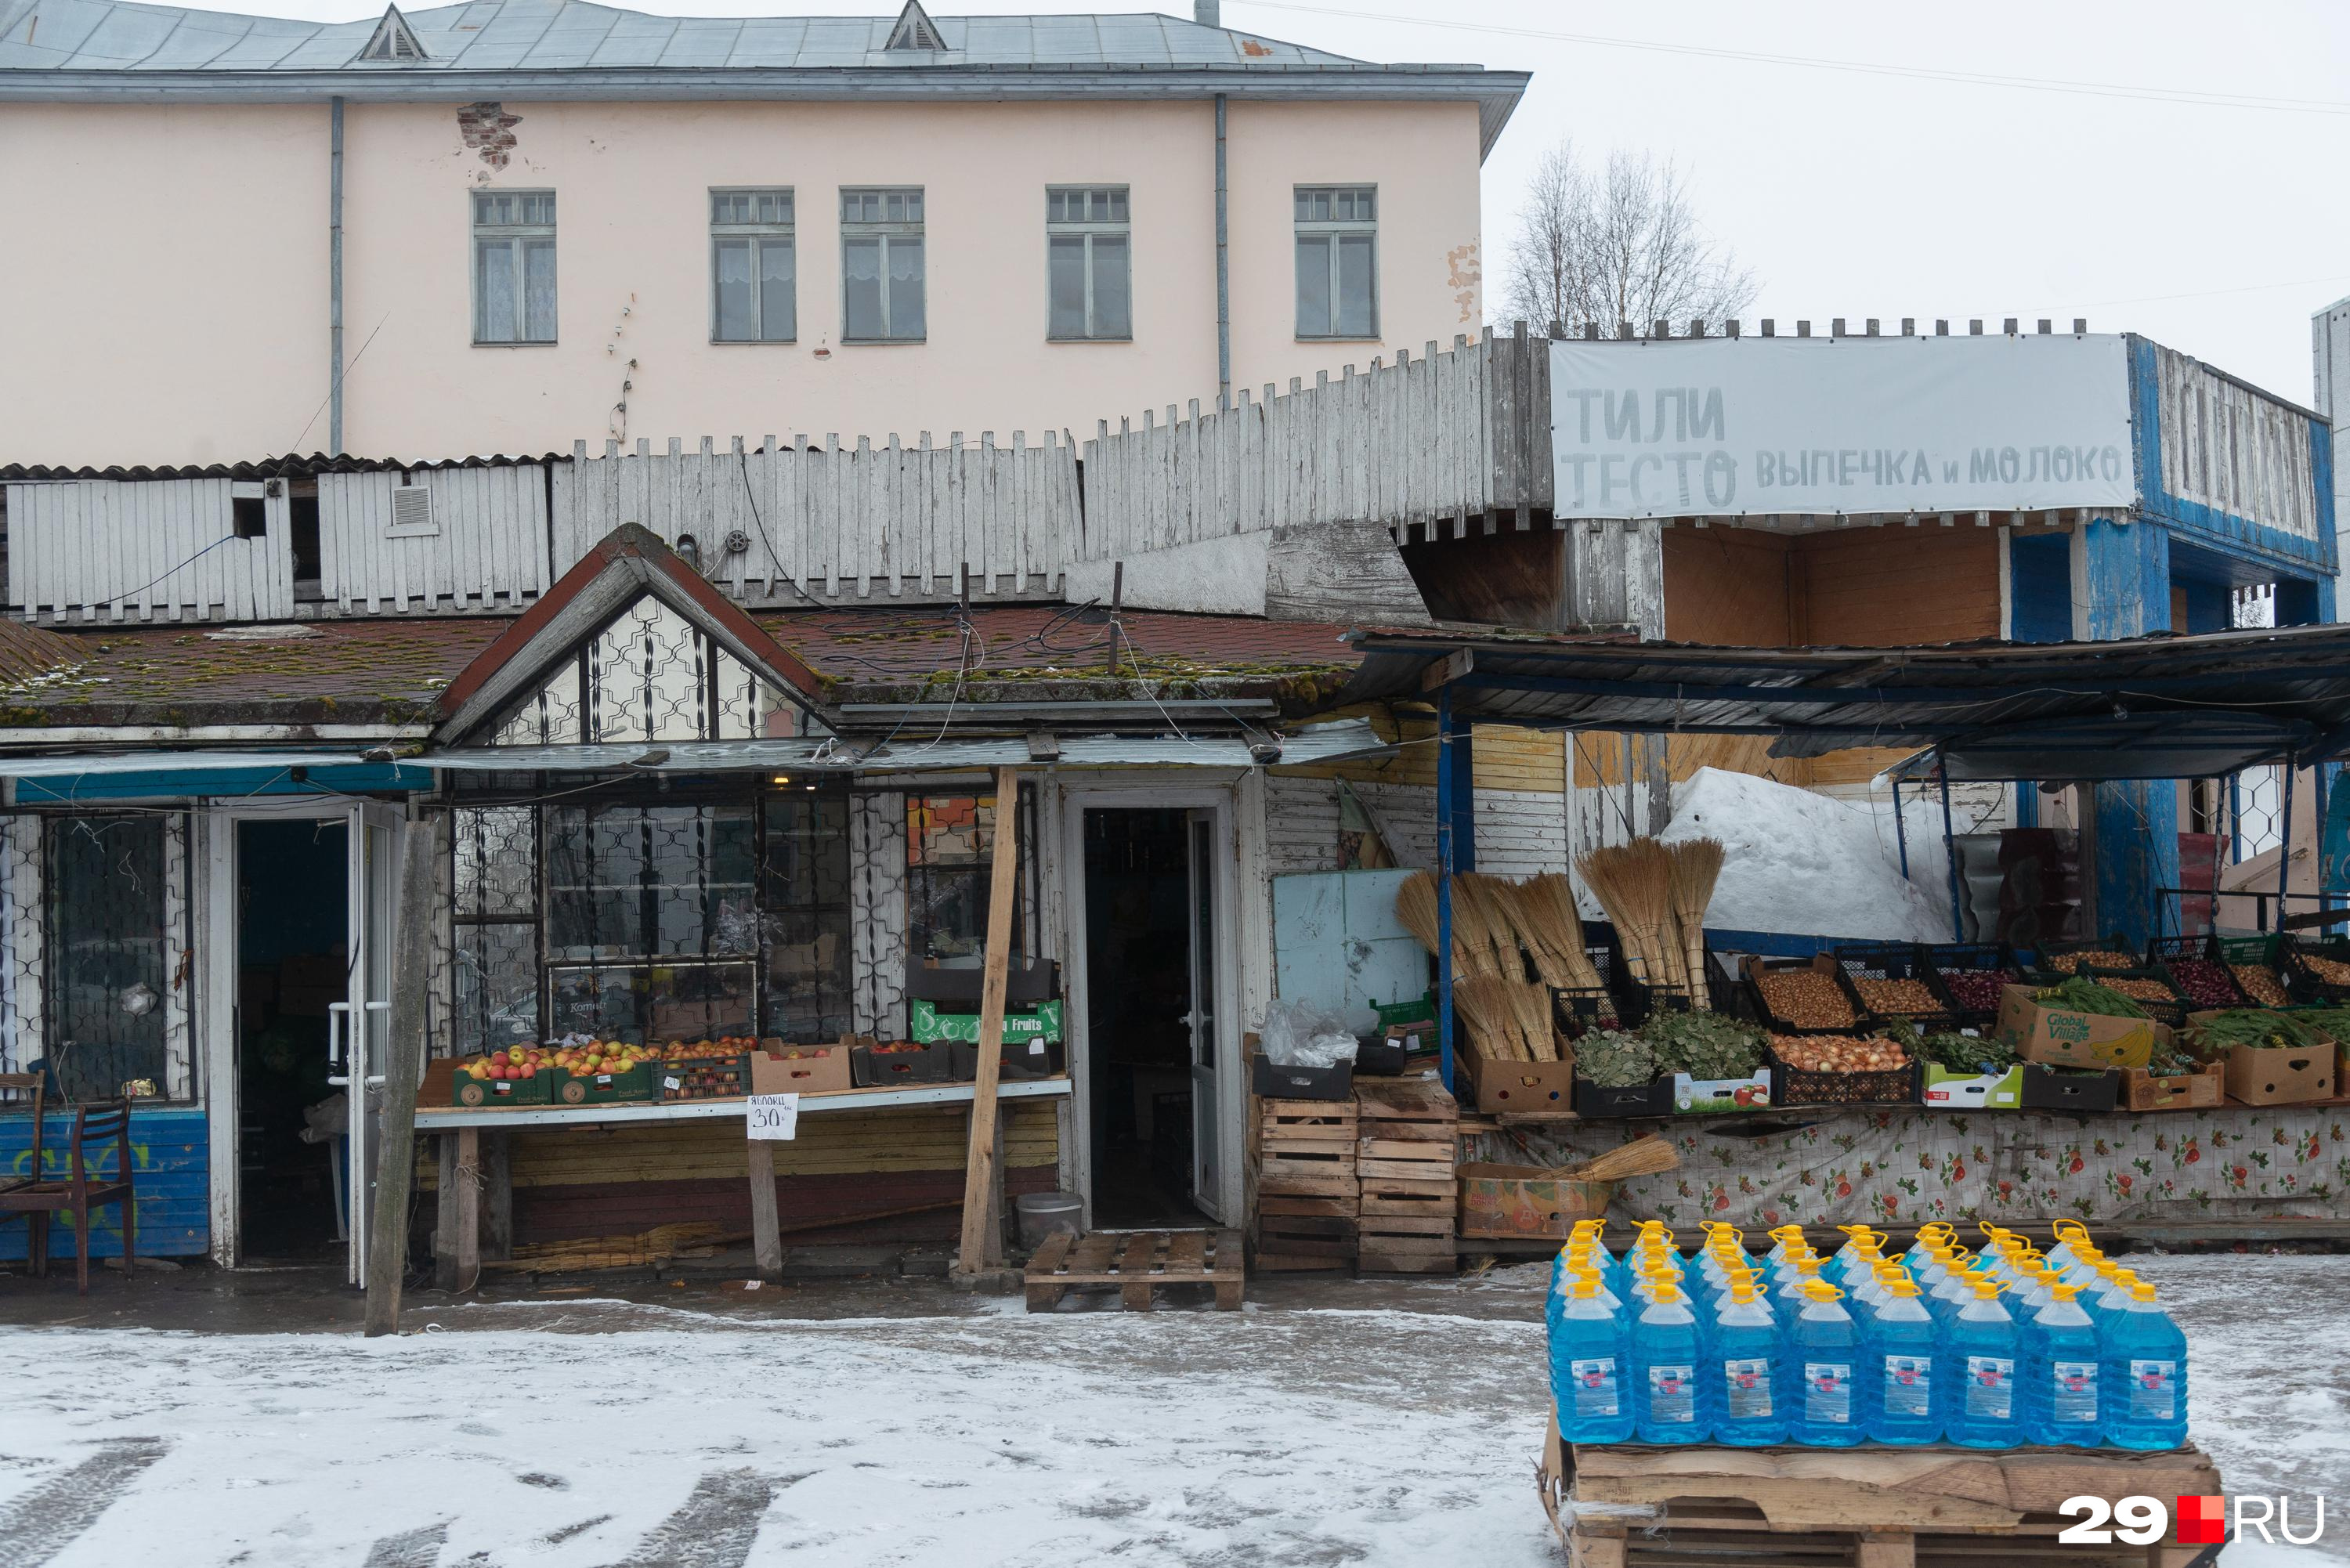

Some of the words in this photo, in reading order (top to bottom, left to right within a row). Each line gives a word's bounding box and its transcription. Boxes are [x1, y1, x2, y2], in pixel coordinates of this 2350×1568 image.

[1567, 387, 1723, 443] ТИЛИ
[1560, 450, 1738, 508] ТЕСТО
[1756, 448, 1932, 488] ВЫПЕЧКА
[1943, 461, 1959, 485] и
[1969, 444, 2123, 485] МОЛОКО
[1012, 1019, 1042, 1031] Fruits
[2047, 1013, 2087, 1027] Global
[2049, 1025, 2089, 1043] Village
